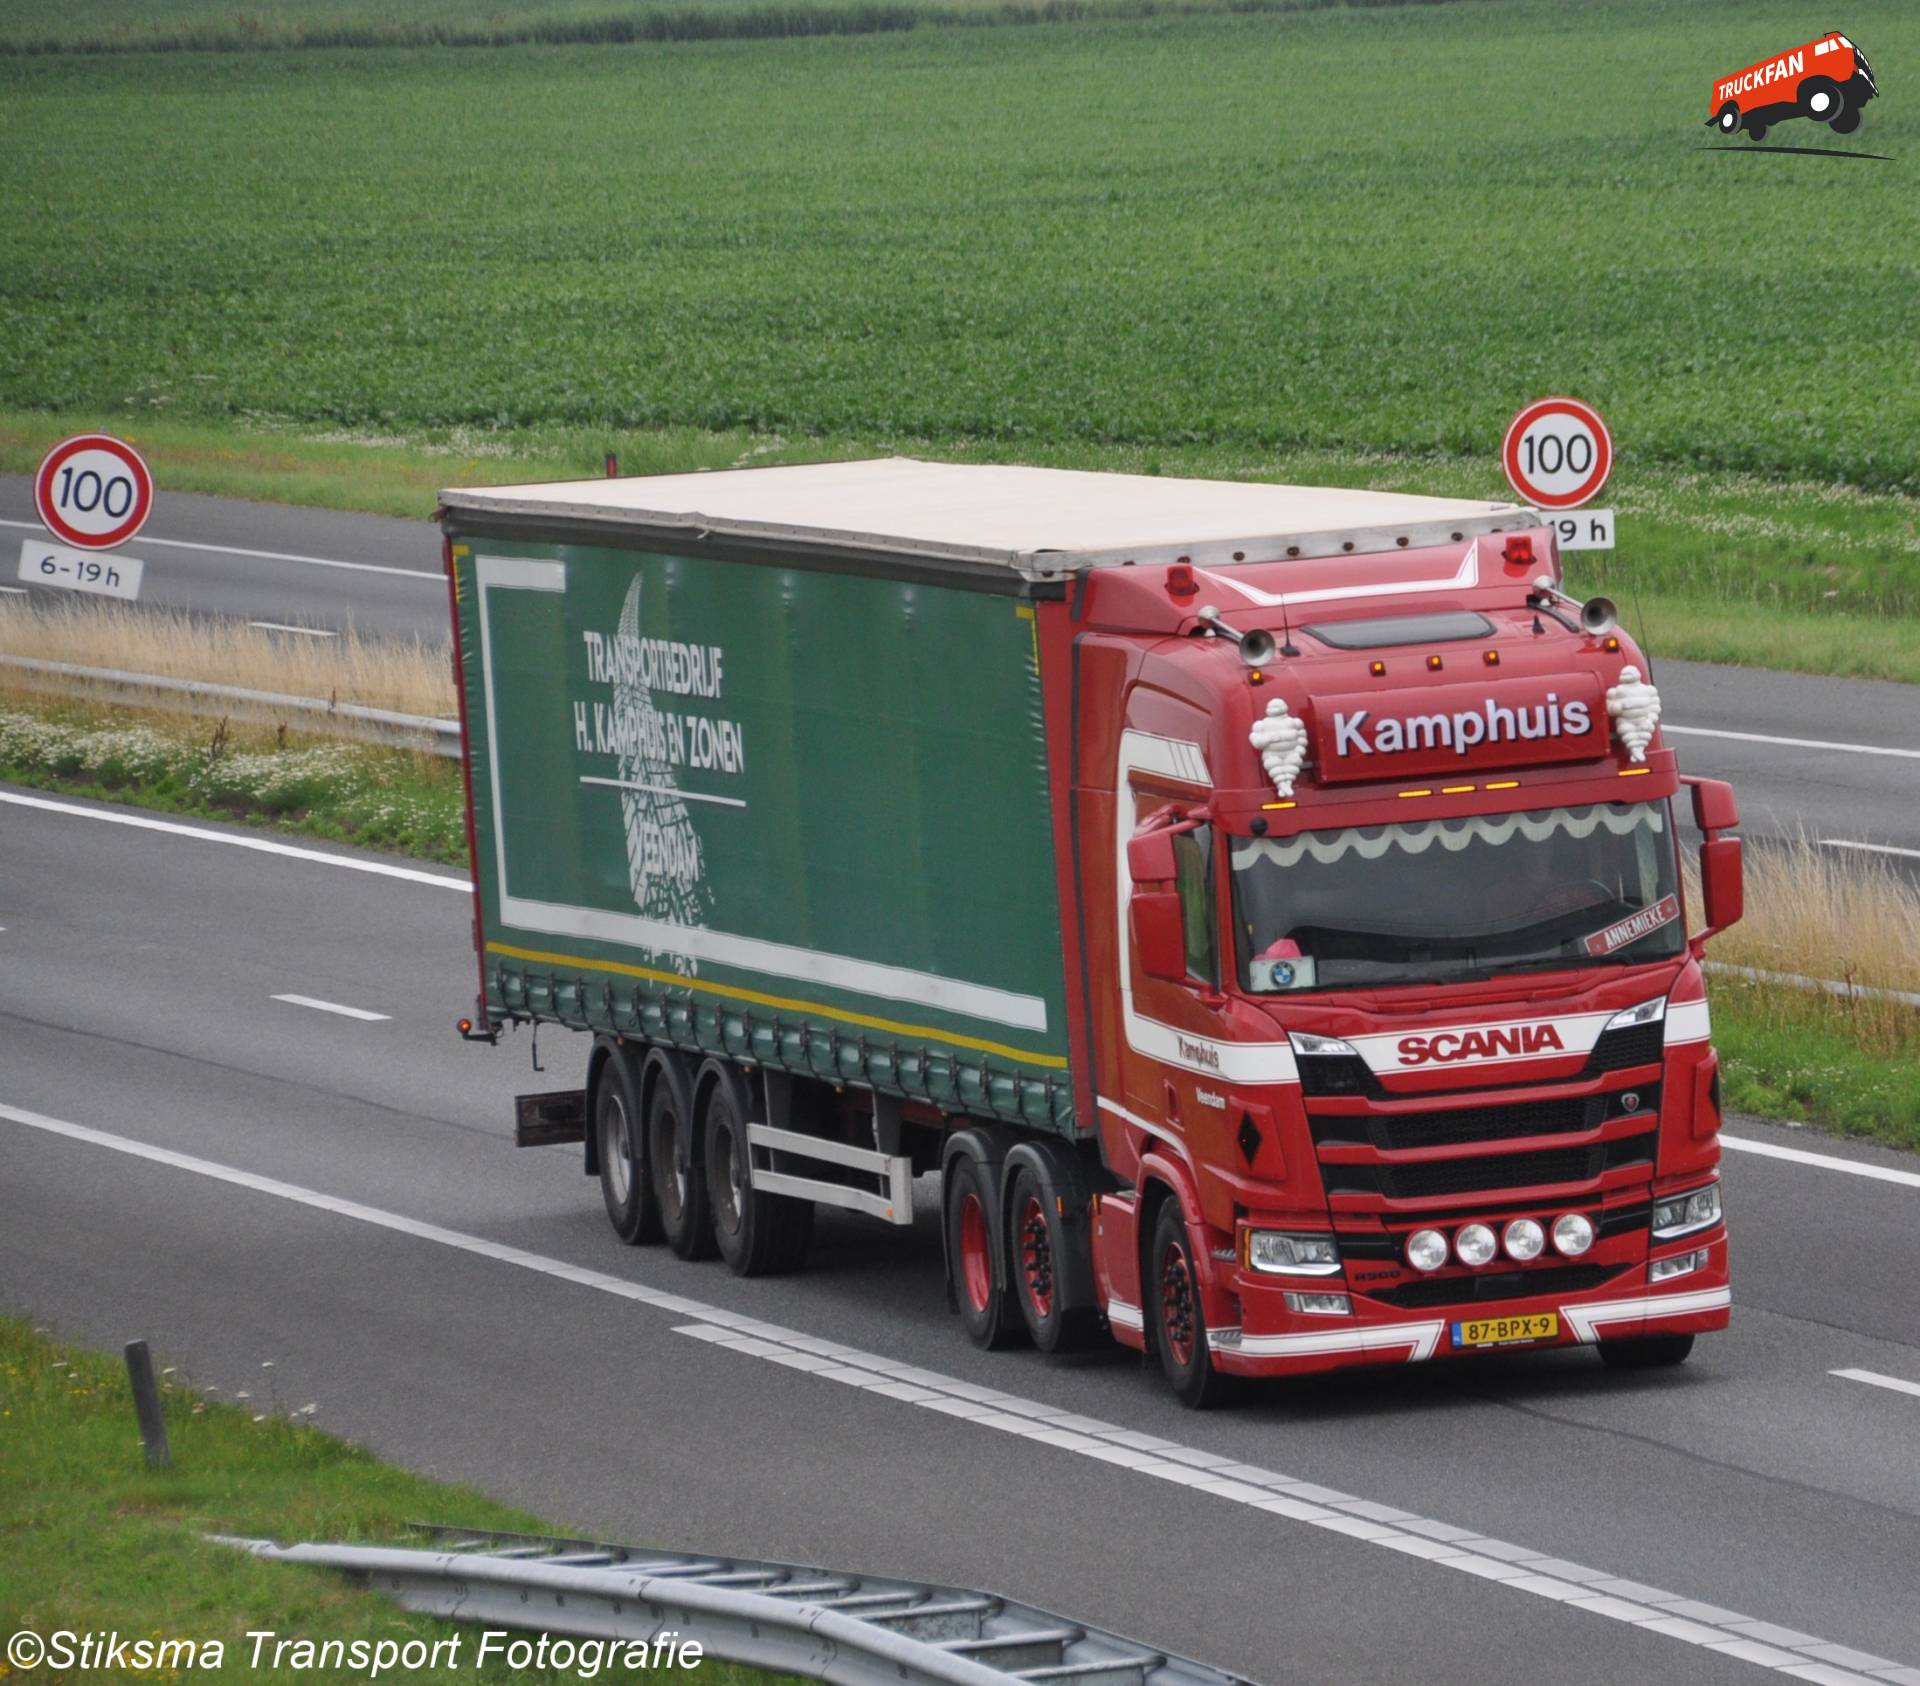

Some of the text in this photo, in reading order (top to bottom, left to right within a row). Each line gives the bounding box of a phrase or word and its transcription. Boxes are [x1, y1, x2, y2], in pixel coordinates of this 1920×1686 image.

[1524, 433, 1592, 475] 100
[60, 466, 133, 519] 100
[1590, 517, 1606, 542] h
[105, 566, 120, 587] h
[583, 630, 724, 699] TRANSPORTBEDRIJF
[573, 700, 745, 774] H. KAMPHUIS EN ZONEN
[1332, 692, 1592, 757] Kamphuis
[1603, 904, 1666, 950] ANNEMIEKE
[1397, 1023, 1566, 1066] SCANIA
[1468, 1317, 1551, 1341] 87-BPX-9
